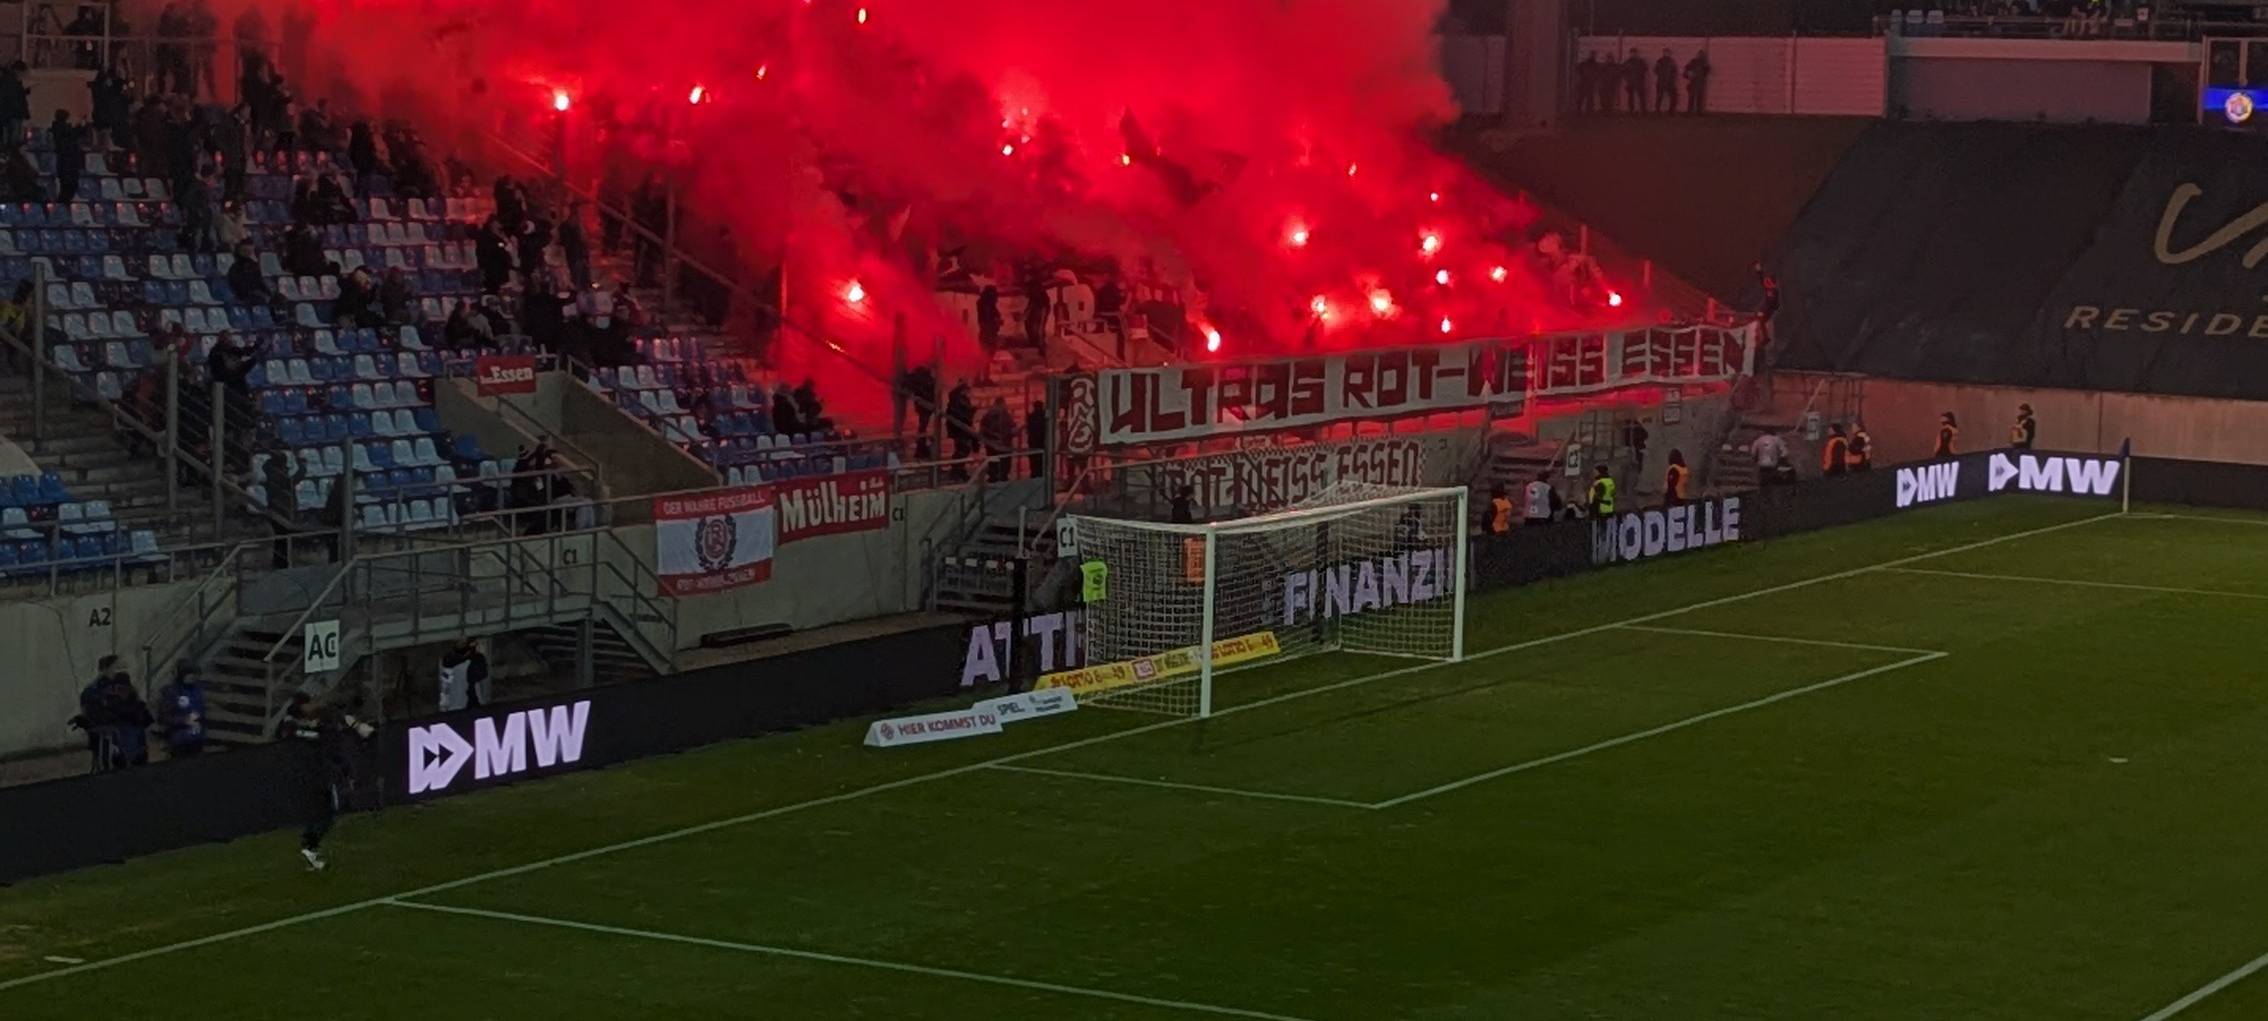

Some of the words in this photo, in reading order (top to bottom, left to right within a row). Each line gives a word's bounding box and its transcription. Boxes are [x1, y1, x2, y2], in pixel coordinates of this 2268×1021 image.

[1110, 359, 1326, 434] ULTRAS
[1343, 338, 1605, 408] ROT-WEISS
[1622, 327, 1747, 377] ESSEN
[1336, 441, 1420, 488] ESSEN
[89, 608, 111, 627] A2
[898, 722, 926, 736] HIER
[927, 716, 977, 732] KOMMST
[978, 713, 996, 726] DU
